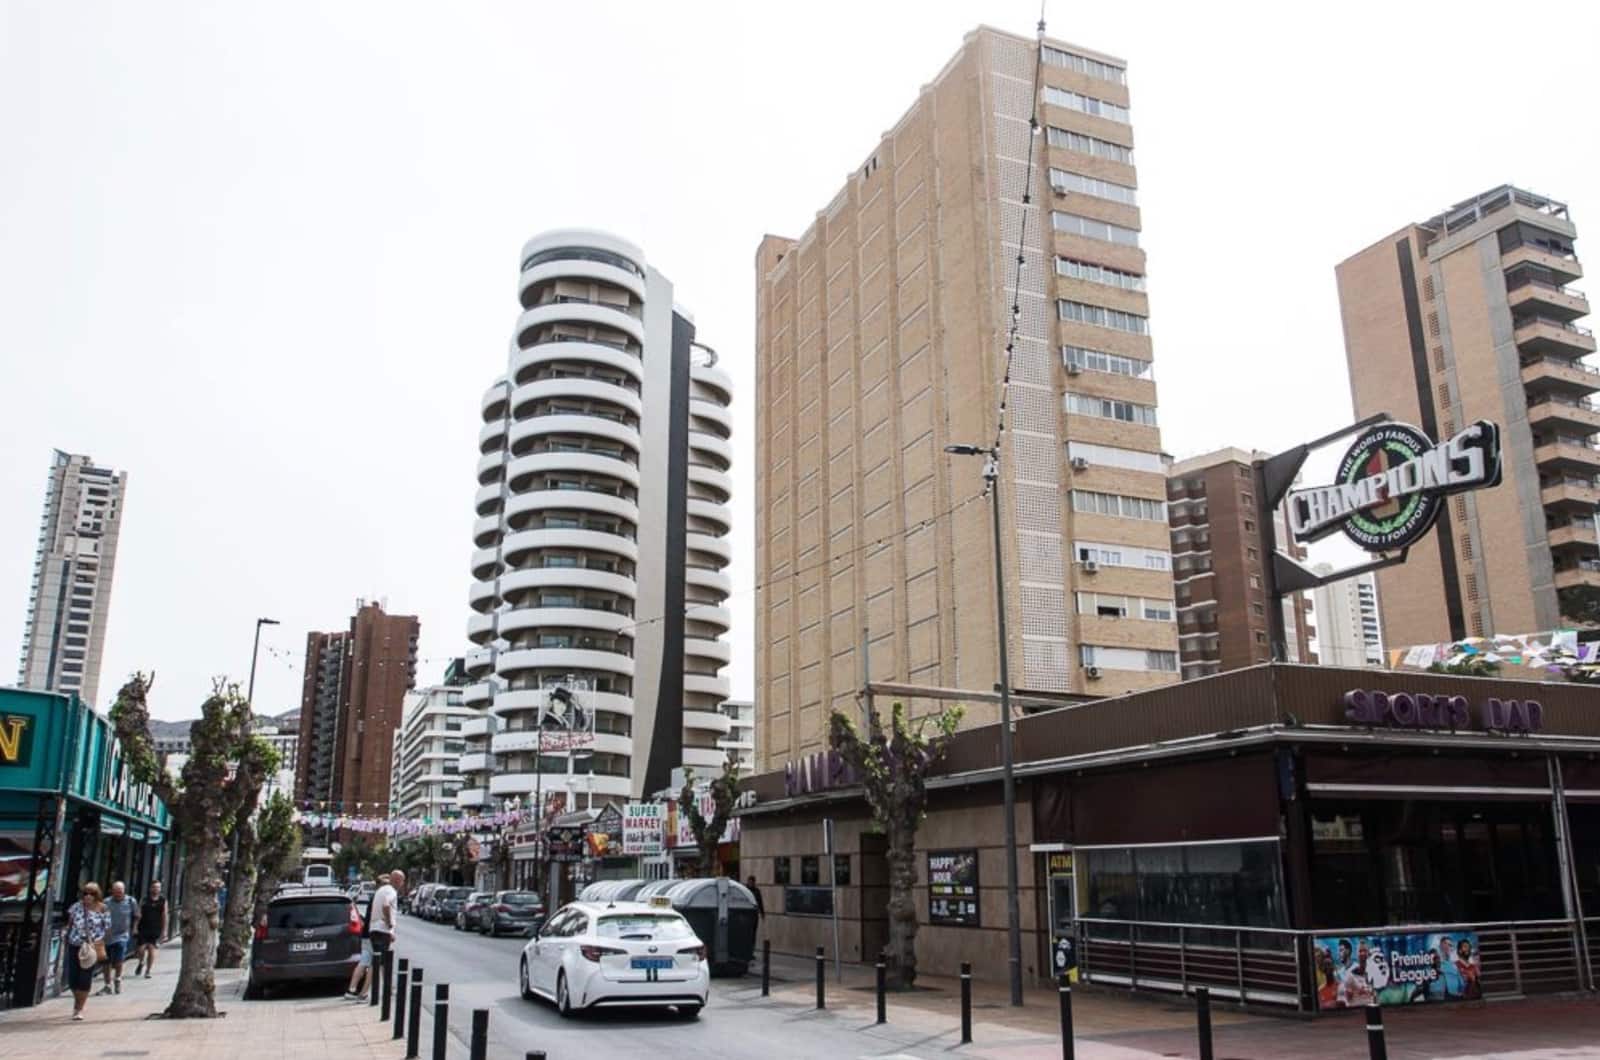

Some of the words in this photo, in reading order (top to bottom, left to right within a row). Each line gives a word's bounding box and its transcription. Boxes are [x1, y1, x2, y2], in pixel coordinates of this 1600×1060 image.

[1353, 431, 1385, 456] WORLD
[1385, 430, 1421, 452] FAMOUS
[1287, 424, 1485, 535] CHAMPIONS
[1344, 688, 1470, 728] SPORTS
[1484, 697, 1543, 729] BAR
[629, 806, 658, 817] SUPER
[625, 819, 661, 829] MARKET
[1050, 855, 1072, 869] ATM
[1391, 949, 1435, 966] Premier
[1393, 966, 1437, 985] League
